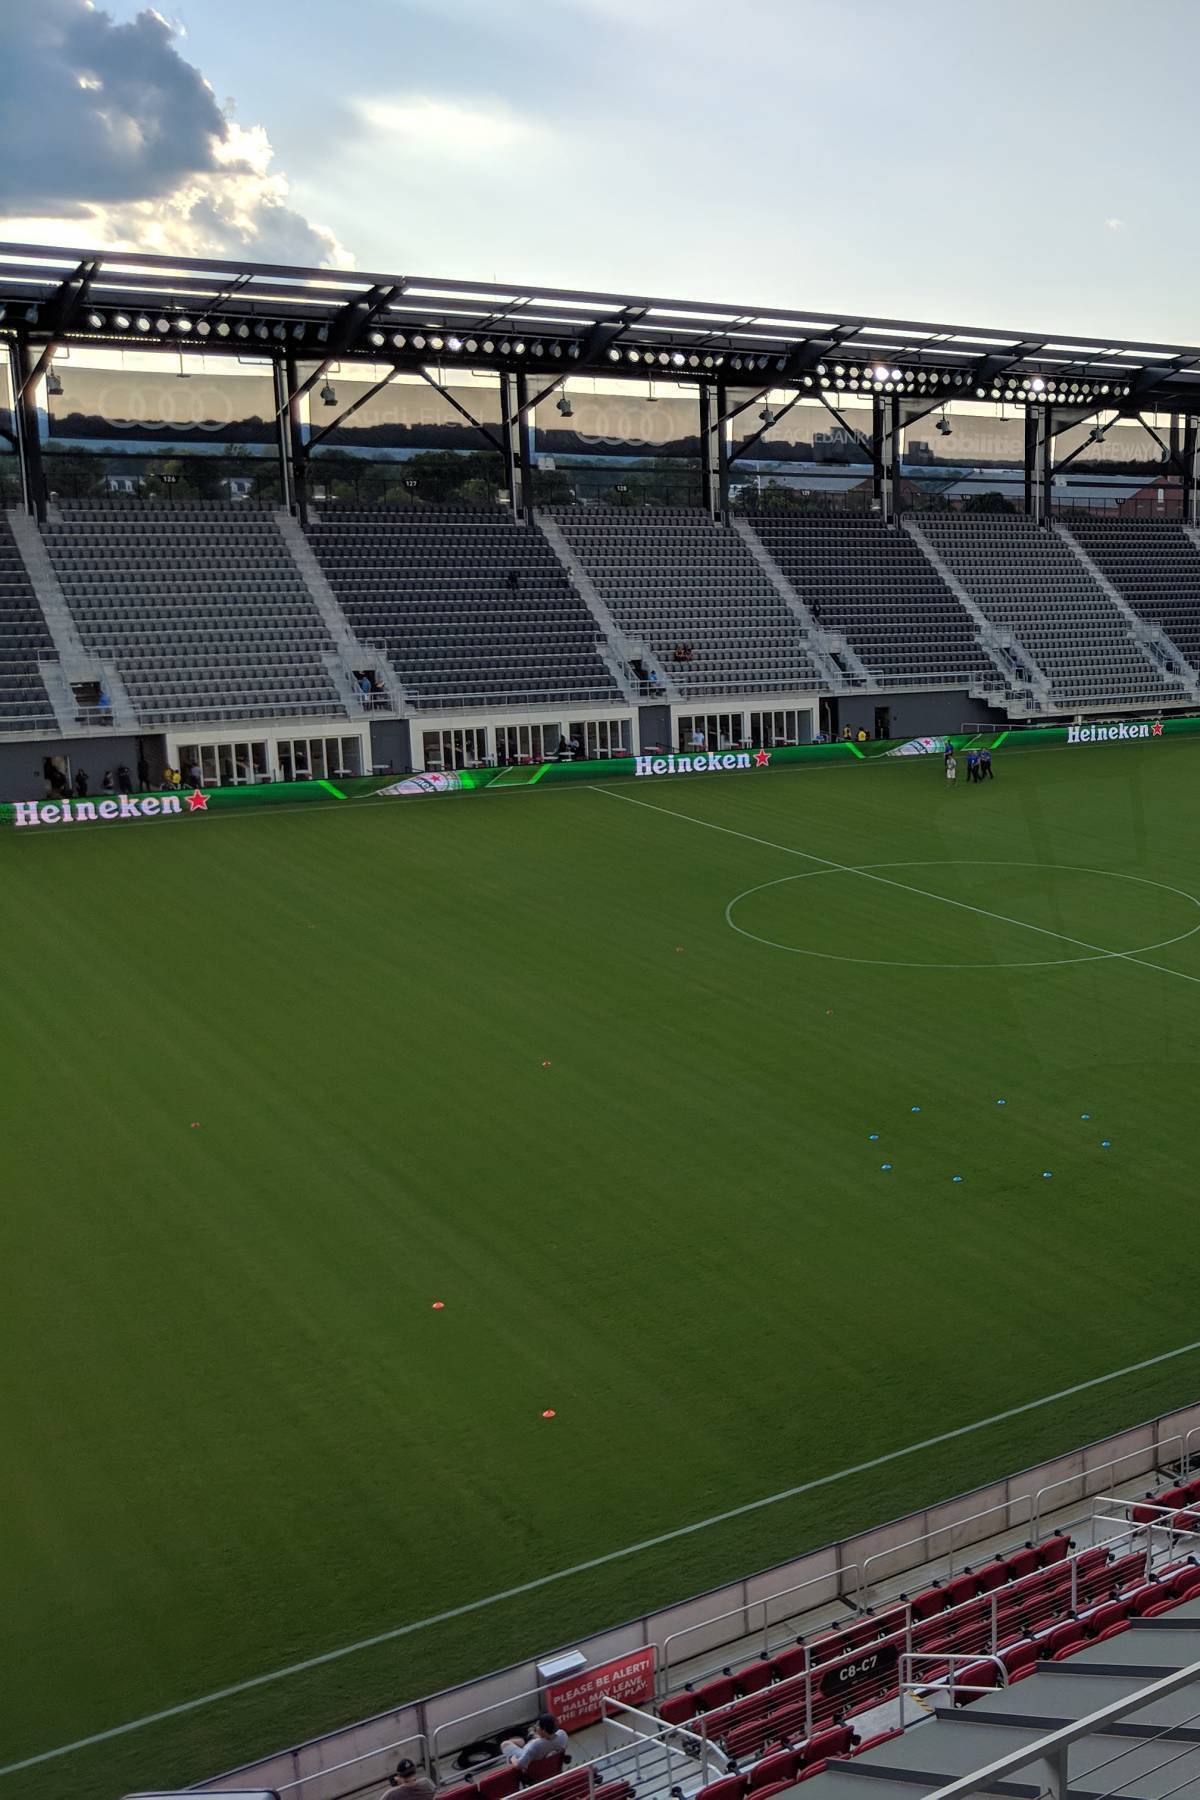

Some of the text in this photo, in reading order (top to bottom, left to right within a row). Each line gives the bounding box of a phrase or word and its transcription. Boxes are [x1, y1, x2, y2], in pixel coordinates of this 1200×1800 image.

[1067, 722, 1150, 744] Heineken
[635, 750, 752, 776] Heineken
[14, 794, 183, 827] Heineken
[839, 1654, 878, 1681] C8-C7
[553, 1660, 650, 1705] PLEASE BE ALERT!
[563, 1675, 643, 1713] BALL MAY LEAVE
[557, 1710, 576, 1724] THE
